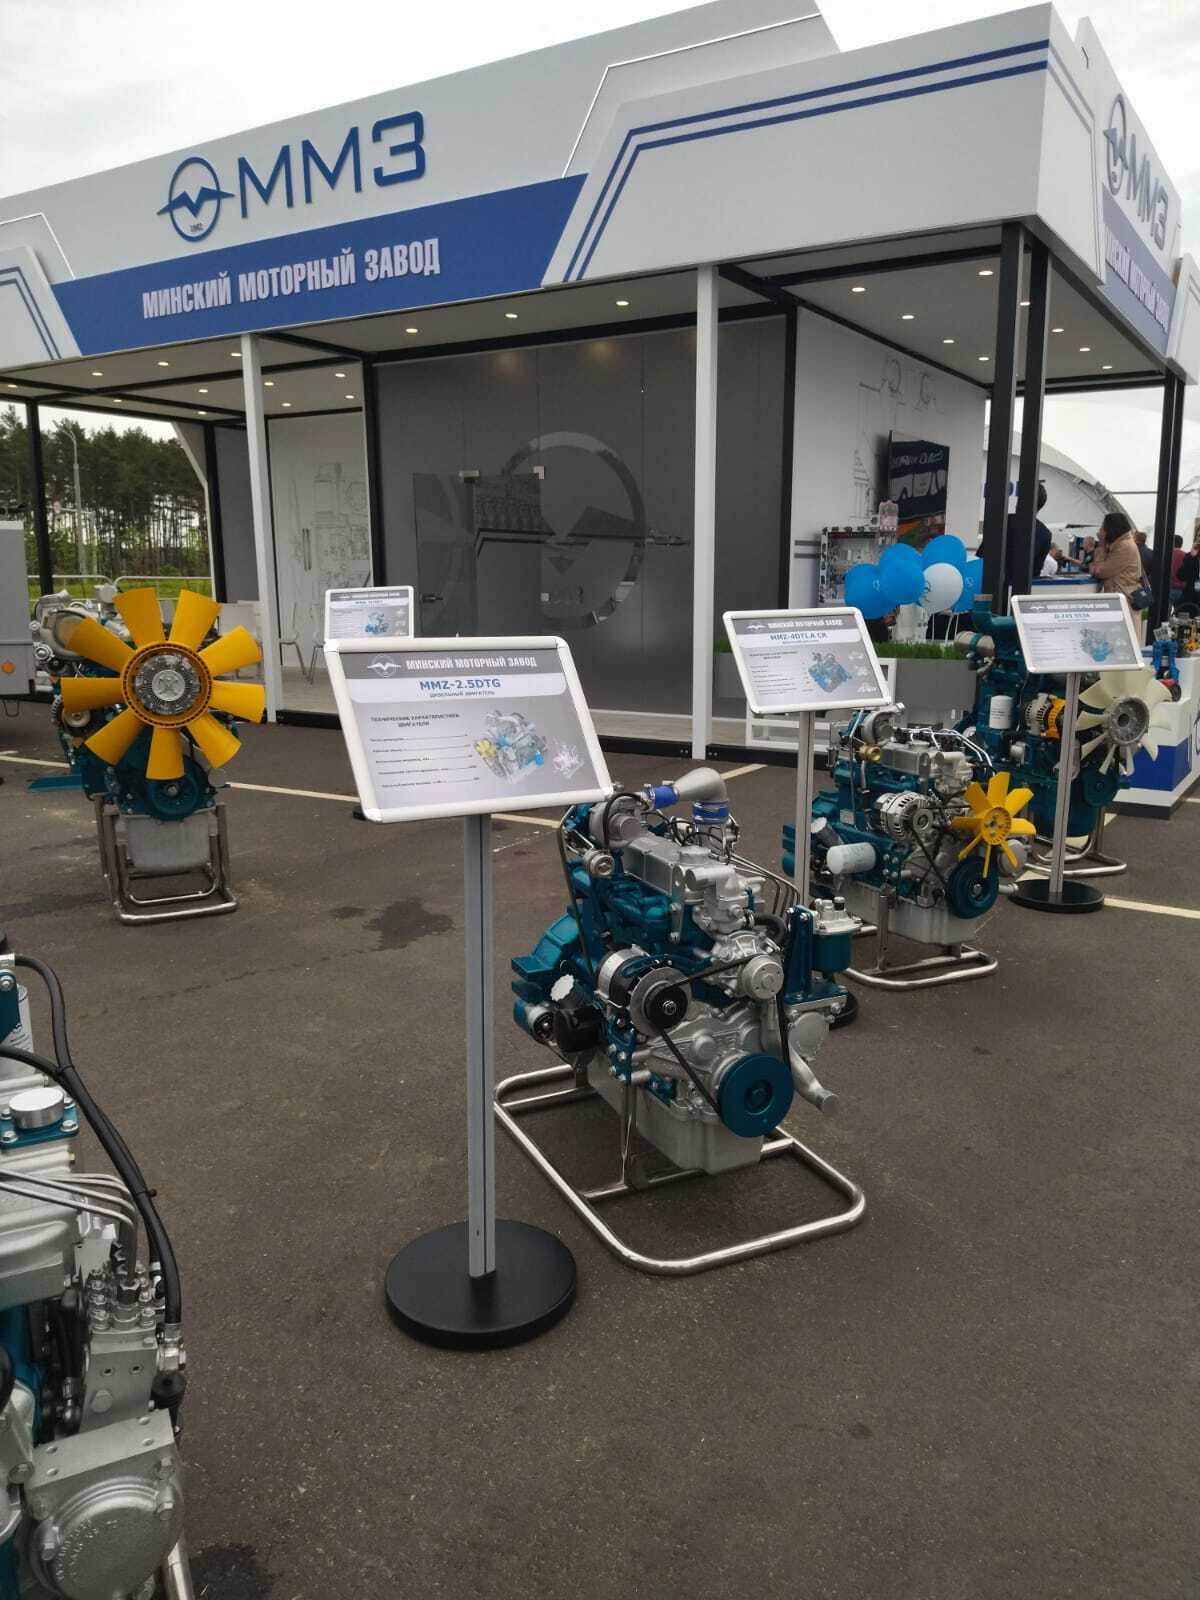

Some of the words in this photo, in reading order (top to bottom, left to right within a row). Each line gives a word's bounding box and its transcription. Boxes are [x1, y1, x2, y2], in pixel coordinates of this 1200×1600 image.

[238, 110, 427, 218] ММЗ
[142, 272, 232, 319] МИНСКИЙ
[238, 248, 356, 302] МОТОРНЫЙ
[364, 238, 441, 282] ЗАВОД
[406, 657, 451, 670] МИНСКИЙ
[455, 656, 506, 669] МОТОРНЫЙ
[508, 656, 537, 667] ЗАВОД
[419, 678, 501, 691] MMZ-2.5DTG
